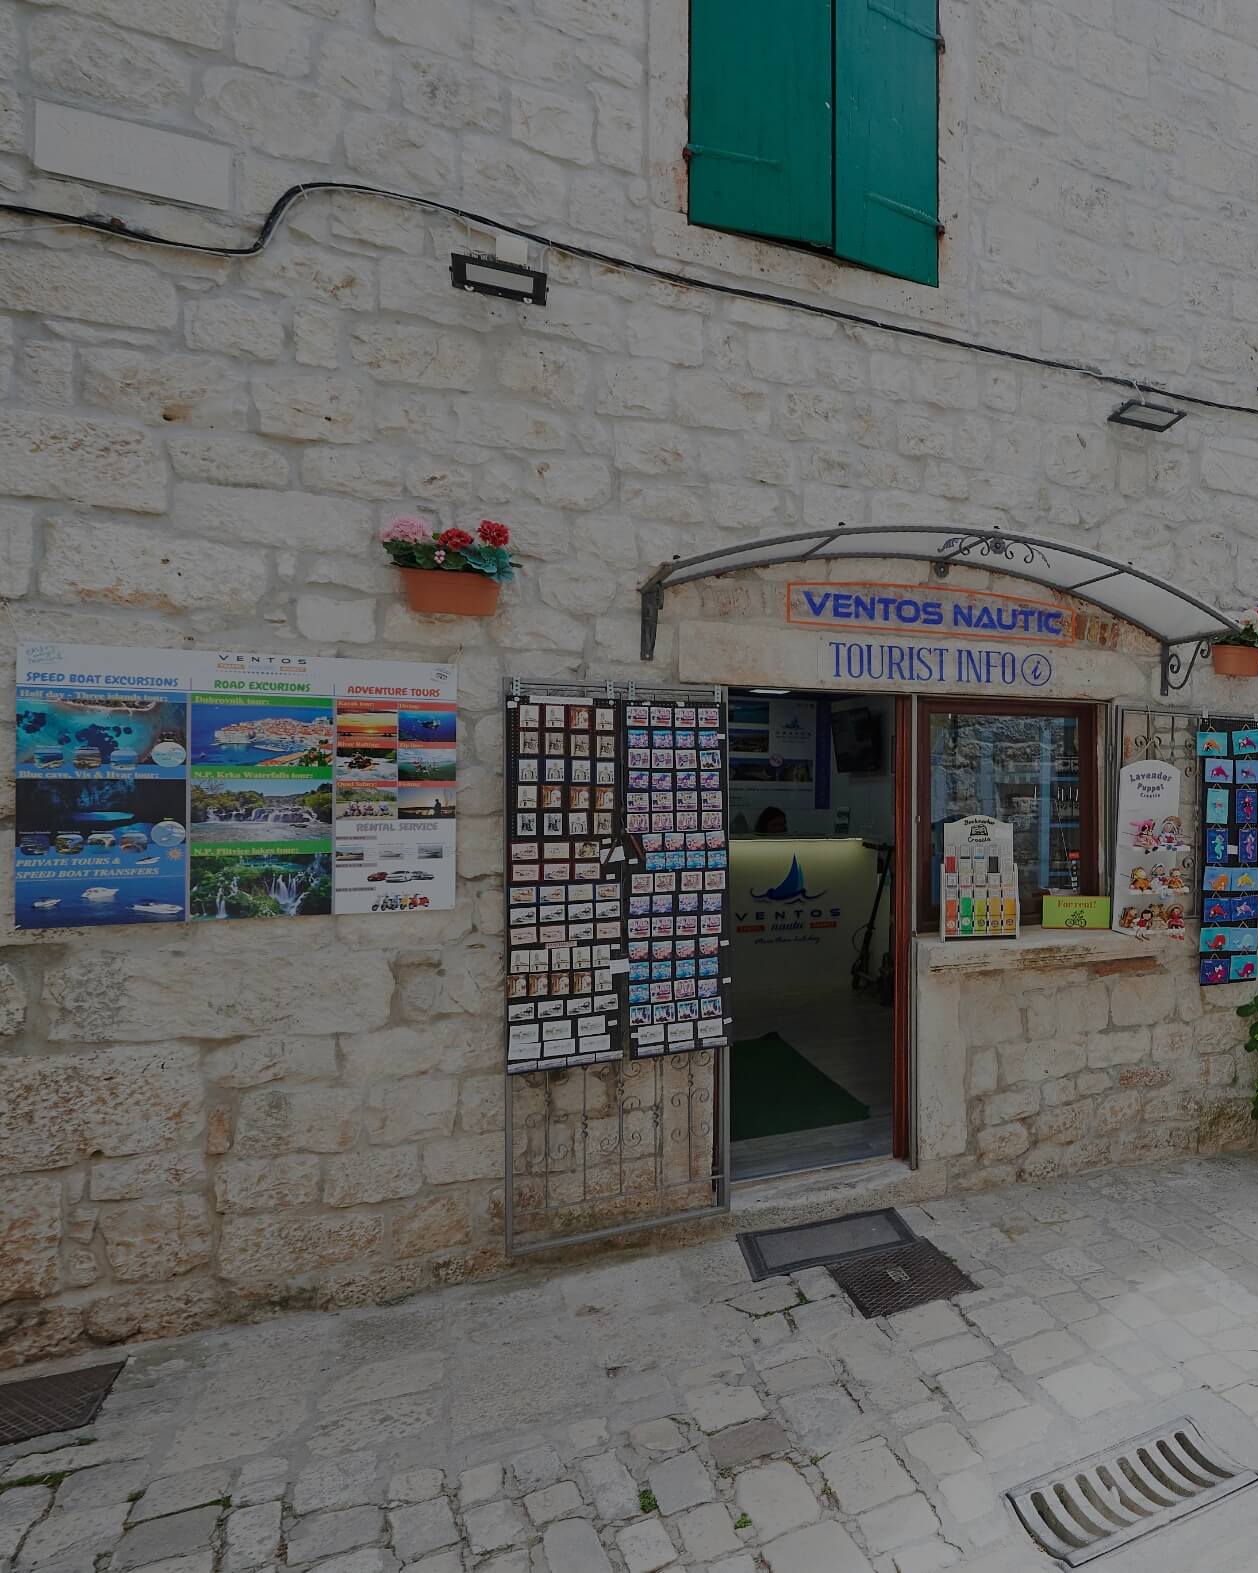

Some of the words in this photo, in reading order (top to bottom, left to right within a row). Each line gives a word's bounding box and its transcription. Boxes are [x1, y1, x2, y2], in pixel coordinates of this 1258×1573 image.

[803, 591, 944, 626] VENTOS
[952, 604, 1063, 636] NAUTIC
[219, 655, 307, 665] VENTOS
[828, 642, 949, 682] TOURIST
[956, 648, 1016, 685] INFO
[26, 672, 65, 682] SPEED
[70, 674, 102, 684] BOAT
[104, 675, 179, 688] EXCURSIONS
[214, 680, 246, 690] ROAD
[248, 682, 312, 692] EXCURIONS
[20, 690, 42, 698] Half
[347, 686, 408, 696] ADVENTURE
[410, 688, 440, 698] TOURS
[1130, 770, 1172, 784] Lavender
[1137, 782, 1166, 793] Puppet
[356, 822, 396, 832] RENTAL
[400, 822, 439, 832] SERVICE
[16, 858, 68, 868] PRIVATE
[71, 857, 110, 866] TOURS
[112, 856, 121, 866] &
[16, 870, 56, 880] SPEED
[58, 870, 90, 878] BOAT
[94, 868, 160, 877] TRANSFERS
[1057, 900, 1073, 909] For
[1074, 900, 1097, 909] rent!
[735, 908, 841, 922] VENTOS
